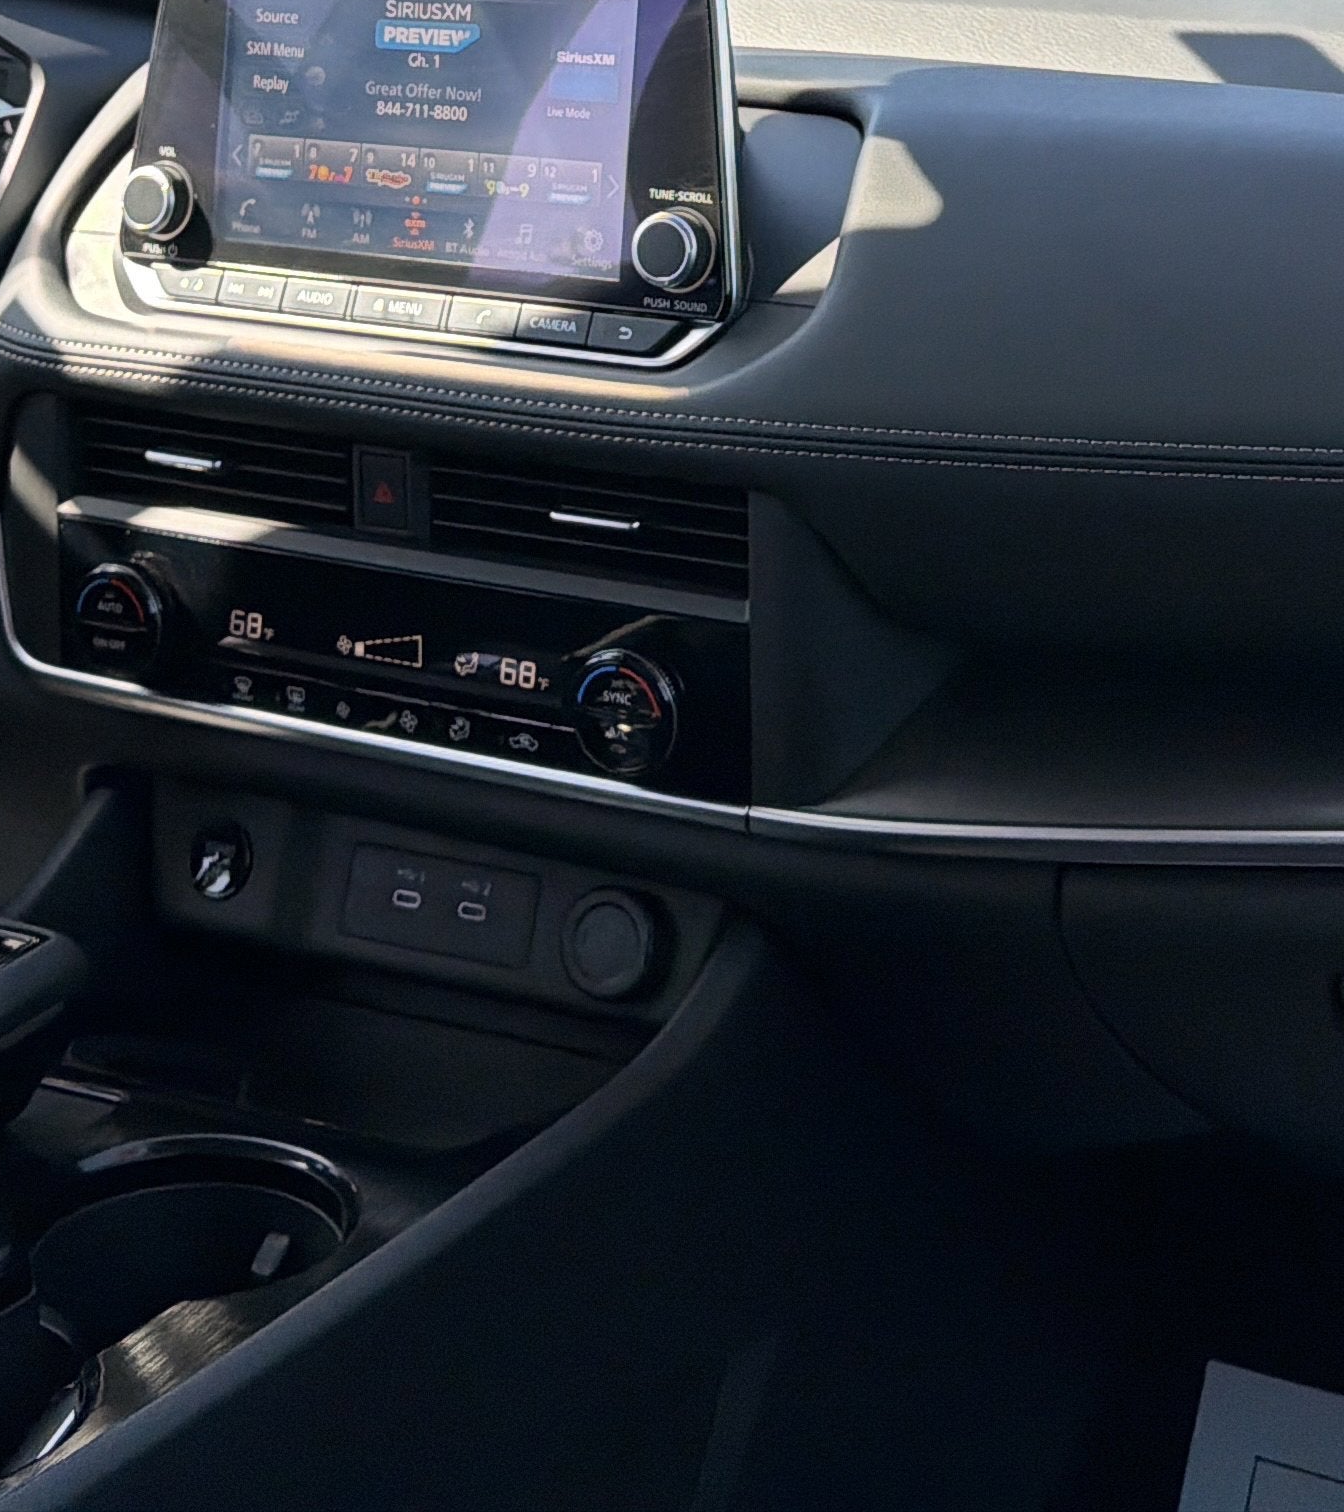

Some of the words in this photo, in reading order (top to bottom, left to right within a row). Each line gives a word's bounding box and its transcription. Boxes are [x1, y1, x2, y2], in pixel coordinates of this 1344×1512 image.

[256, 8, 299, 24] Source
[386, 0, 472, 21] SIRIUSXM
[384, 26, 471, 46] PREVIEW
[246, 41, 272, 56] SXM
[273, 43, 304, 58] Menu
[408, 53, 429, 68] Ch.
[433, 55, 440, 68] 1
[253, 75, 289, 94] Replay
[366, 81, 403, 97] Great
[406, 82, 441, 99] Offer
[445, 84, 482, 102] Now!
[376, 101, 468, 121] 844-711-8800
[547, 106, 564, 117] Live
[565, 107, 591, 120] Mode
[159, 146, 176, 157] VOL
[349, 148, 358, 163] 7
[367, 152, 374, 164] 9
[400, 152, 416, 168] 14
[423, 156, 435, 169] 10
[468, 159, 474, 173] 1
[483, 162, 495, 173] 11
[528, 163, 537, 178] 9
[544, 166, 556, 179] 12
[302, 228, 317, 238] FM
[353, 233, 370, 244] AM
[393, 237, 435, 251] SiriusXM
[446, 242, 458, 253] BT
[572, 256, 612, 271] Settings
[297, 290, 333, 305] AUDIO
[644, 297, 671, 309] PUSH
[673, 299, 708, 313] SOUND
[388, 300, 422, 316] MENU
[530, 317, 577, 333] CAMERA
[97, 600, 123, 614] AUTO
[603, 691, 632, 706] SYNC
